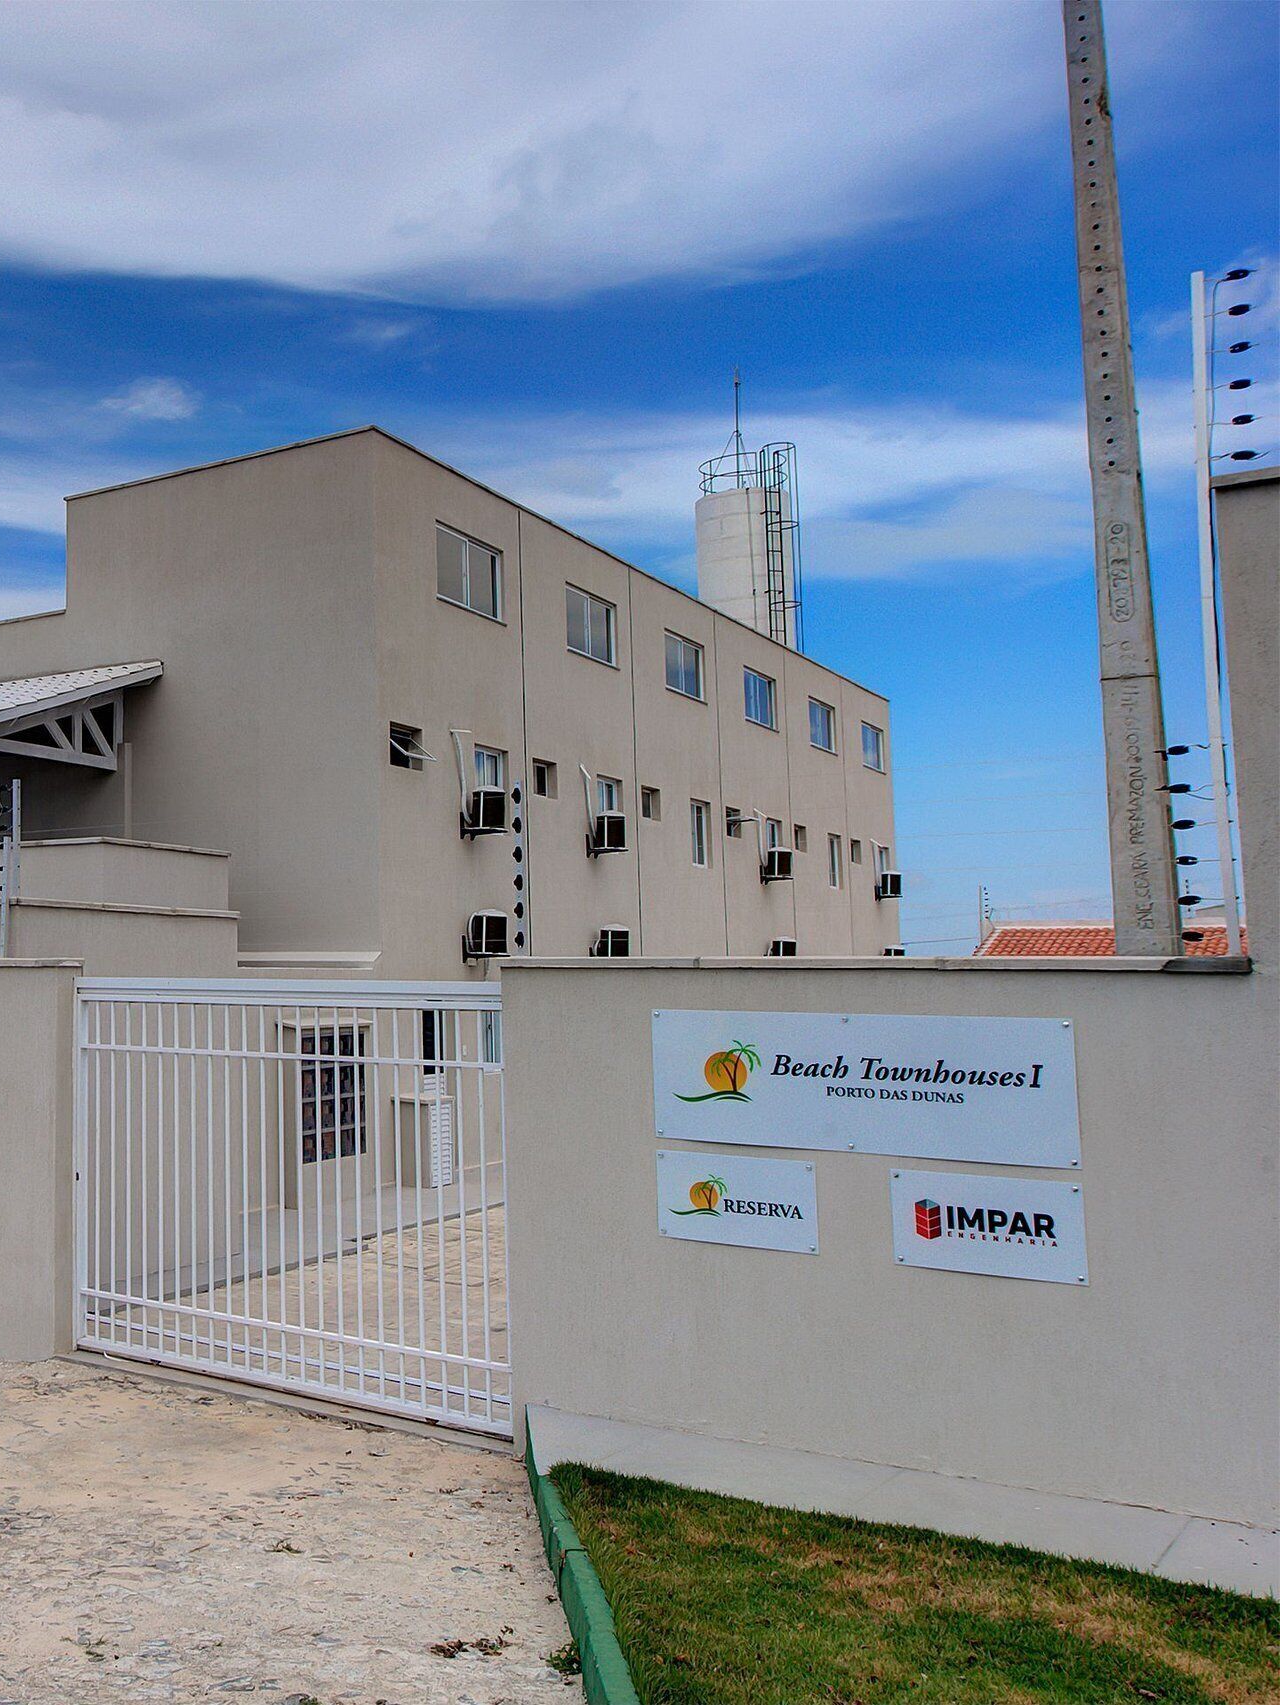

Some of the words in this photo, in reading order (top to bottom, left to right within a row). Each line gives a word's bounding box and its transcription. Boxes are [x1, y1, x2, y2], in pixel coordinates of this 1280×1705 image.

[770, 1054, 849, 1079] Beach
[826, 1086, 875, 1099] PORTO
[879, 1089, 908, 1101] DAS
[911, 1090, 964, 1103] DUNAS
[723, 1199, 804, 1220] RESERVA
[946, 1205, 1056, 1239] IMPAR
[947, 1231, 1058, 1247] ENGENHARIA
